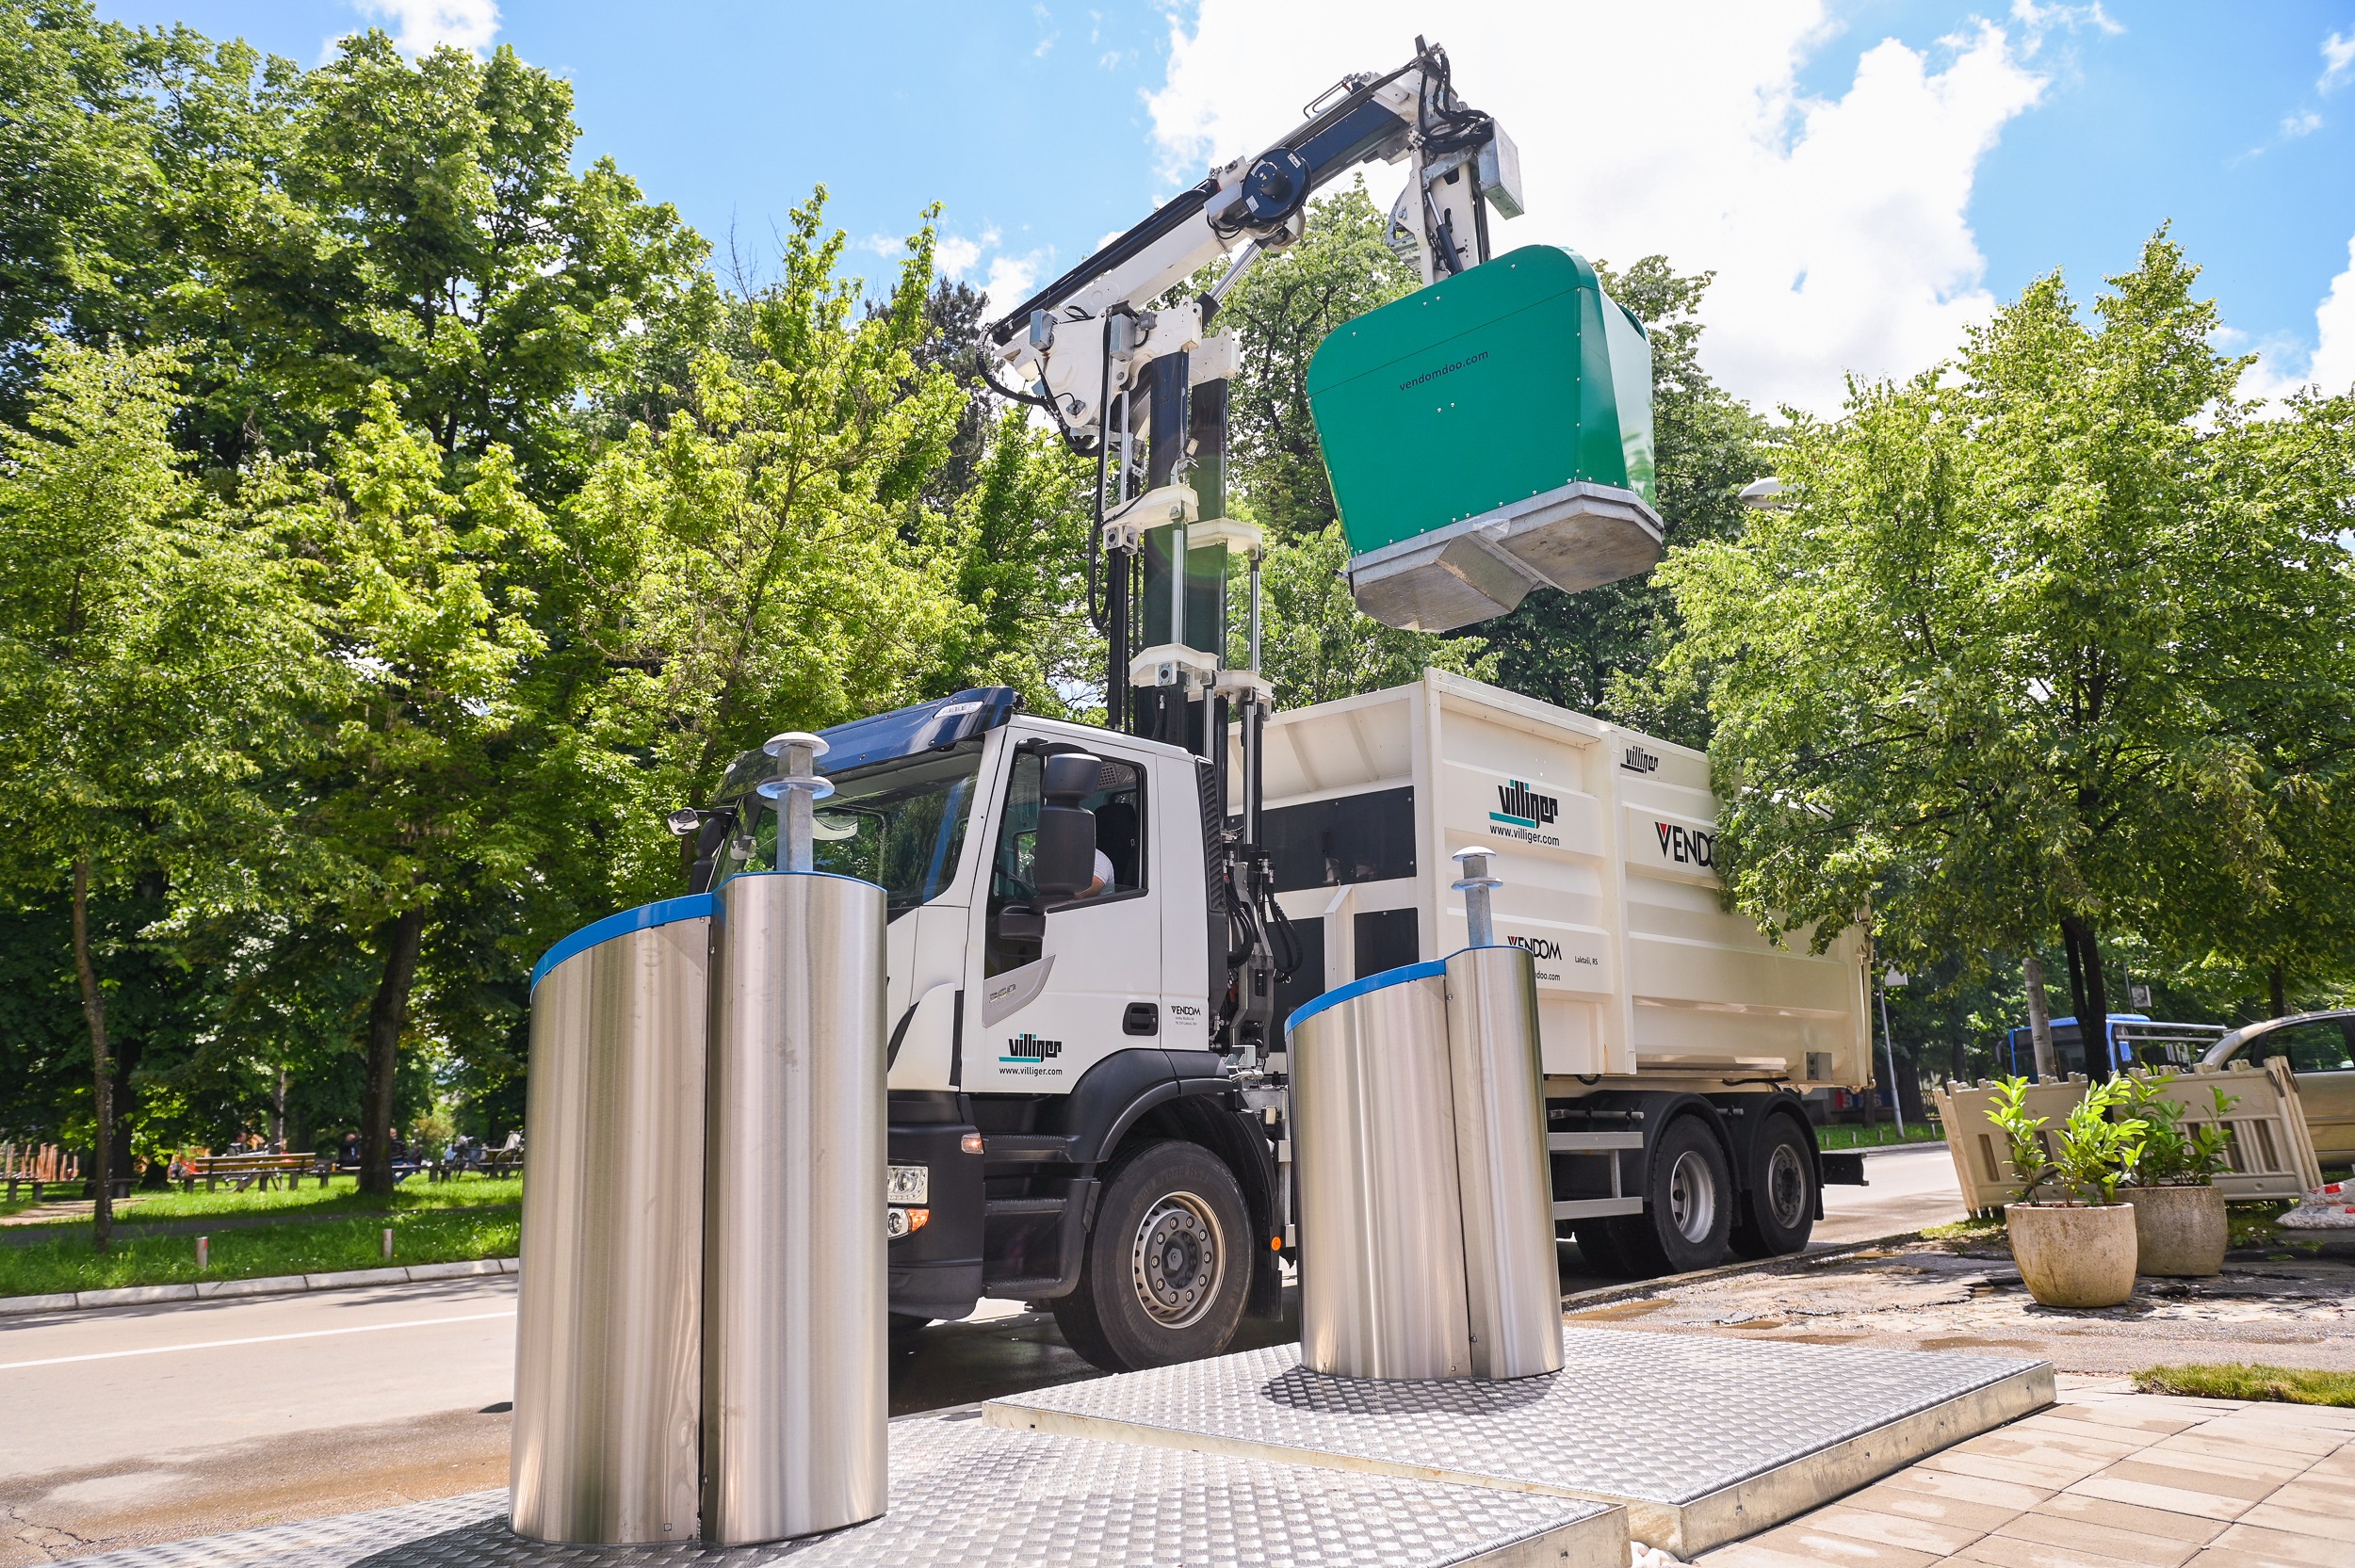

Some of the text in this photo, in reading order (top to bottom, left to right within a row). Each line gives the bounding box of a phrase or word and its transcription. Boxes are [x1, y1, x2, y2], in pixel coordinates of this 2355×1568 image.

[1399, 350, 1489, 391] vendomdoo.com
[1625, 745, 1659, 774] villiger
[1497, 779, 1559, 829] villiger
[1489, 824, 1560, 847] www.villiger.com
[1535, 970, 1561, 981] doo.com
[1171, 1005, 1201, 1016] VENDOM
[1008, 1033, 1063, 1063] villiger
[999, 1066, 1063, 1077] www.villiger.com
